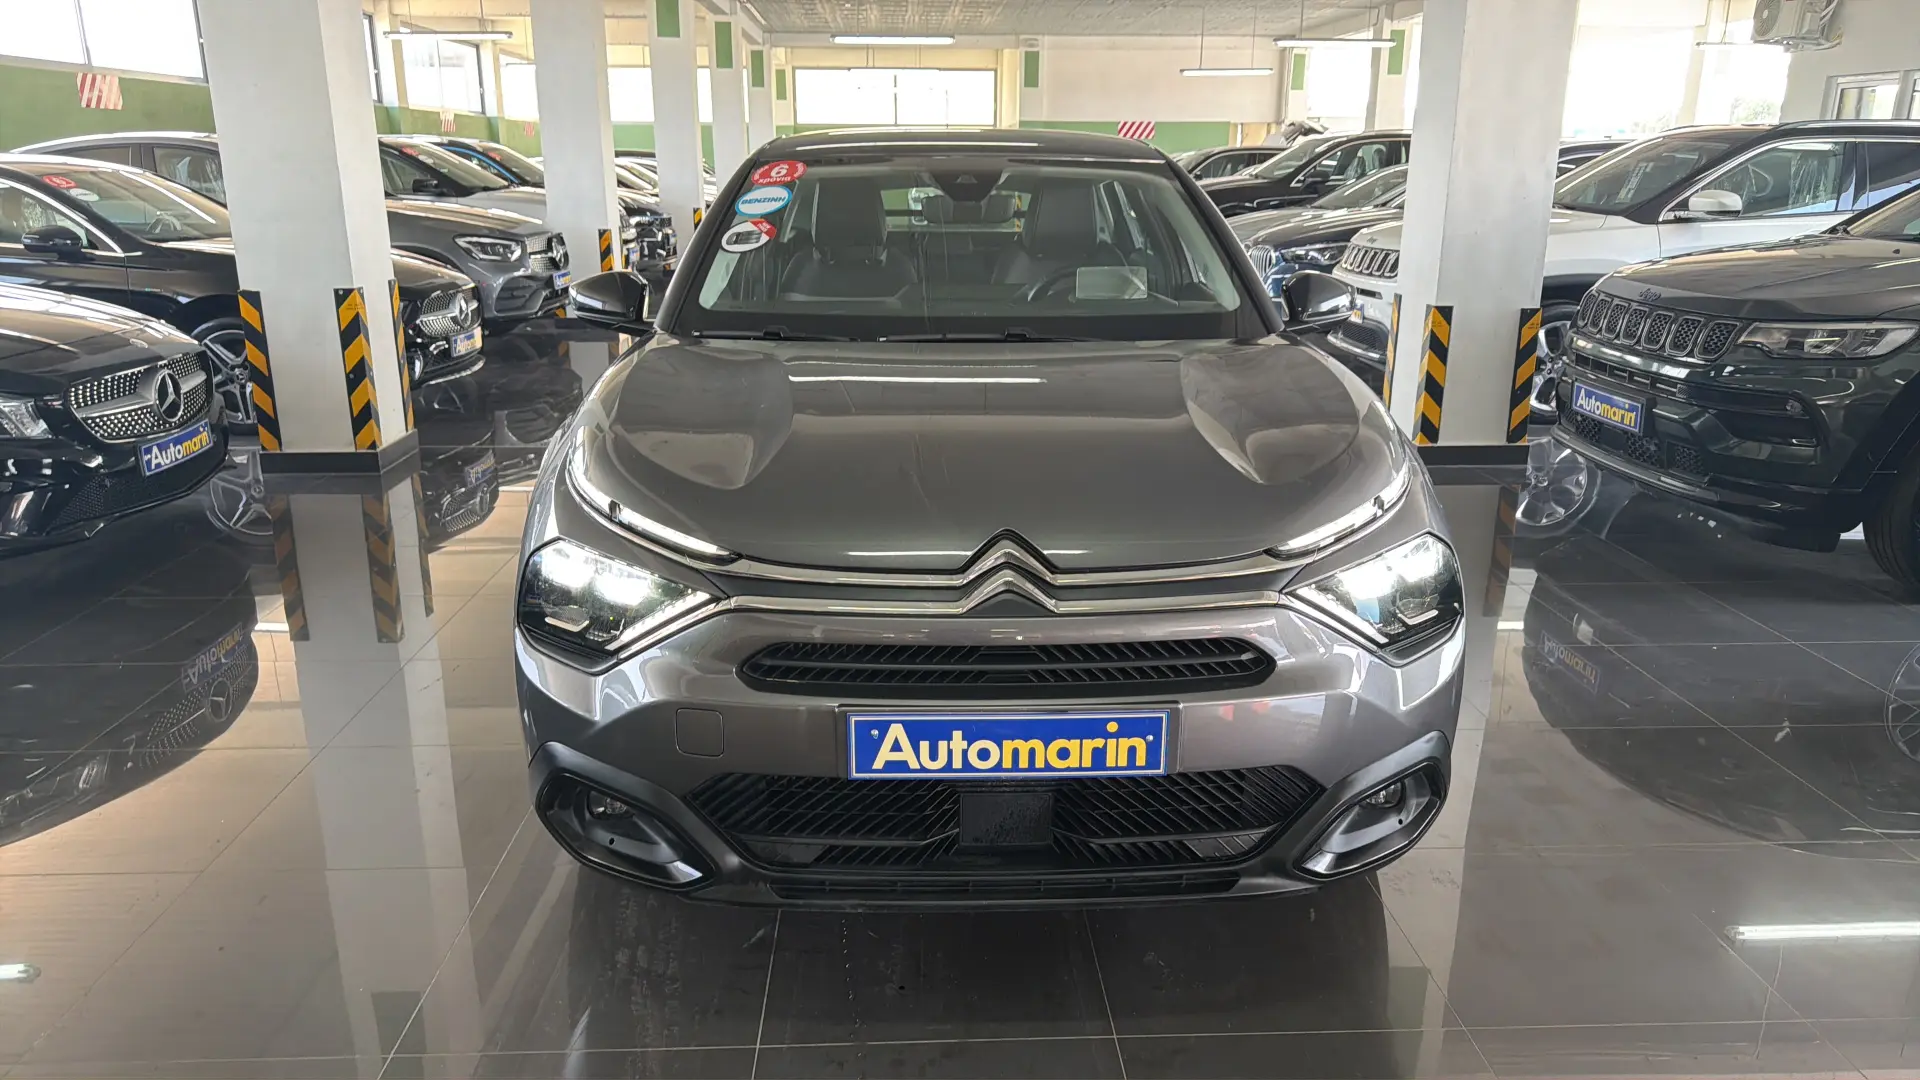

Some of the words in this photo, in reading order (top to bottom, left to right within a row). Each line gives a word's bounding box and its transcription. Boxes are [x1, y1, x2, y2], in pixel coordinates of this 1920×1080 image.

[770, 164, 789, 178] 6
[1576, 387, 1637, 427] Automarin
[151, 426, 209, 470] Automarin
[871, 721, 1147, 770] Automarin
